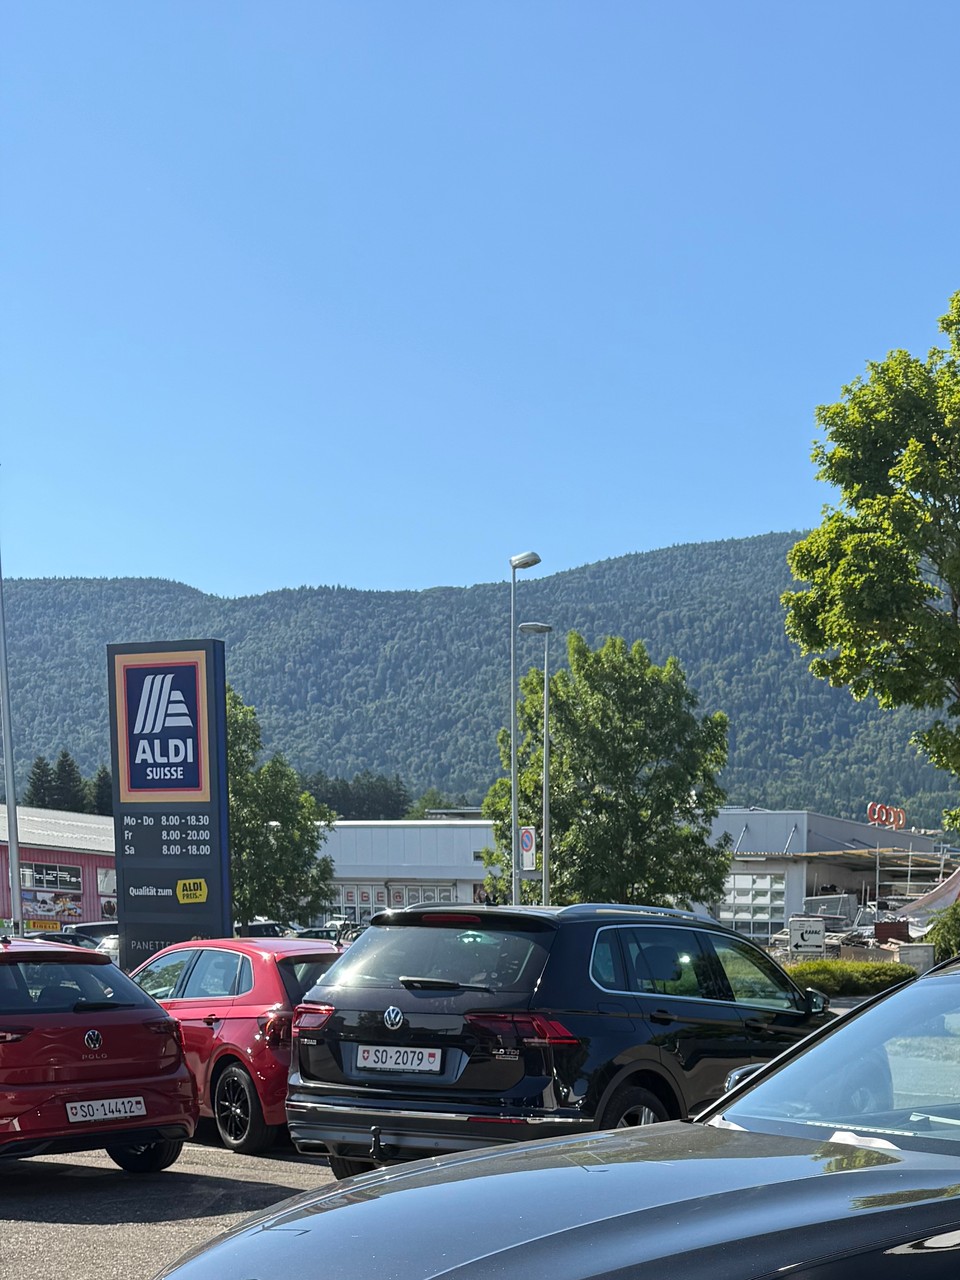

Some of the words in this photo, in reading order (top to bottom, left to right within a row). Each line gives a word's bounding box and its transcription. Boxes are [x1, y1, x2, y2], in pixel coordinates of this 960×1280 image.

[134, 738, 193, 764] ALDI
[146, 766, 184, 780] SUISSE
[123, 815, 136, 826] Mo
[143, 815, 154, 826] Do
[161, 815, 180, 825] 8.00
[186, 815, 209, 825] 18.30
[124, 830, 133, 840] Fr
[161, 830, 181, 840] 8.00
[186, 830, 210, 840] 20.00
[124, 845, 135, 855] Sa
[162, 845, 181, 855] 8.00
[187, 845, 211, 855] 18.00
[129, 886, 157, 896] Qualität
[181, 882, 203, 892] ALDI
[131, 940, 176, 951] PANETT
